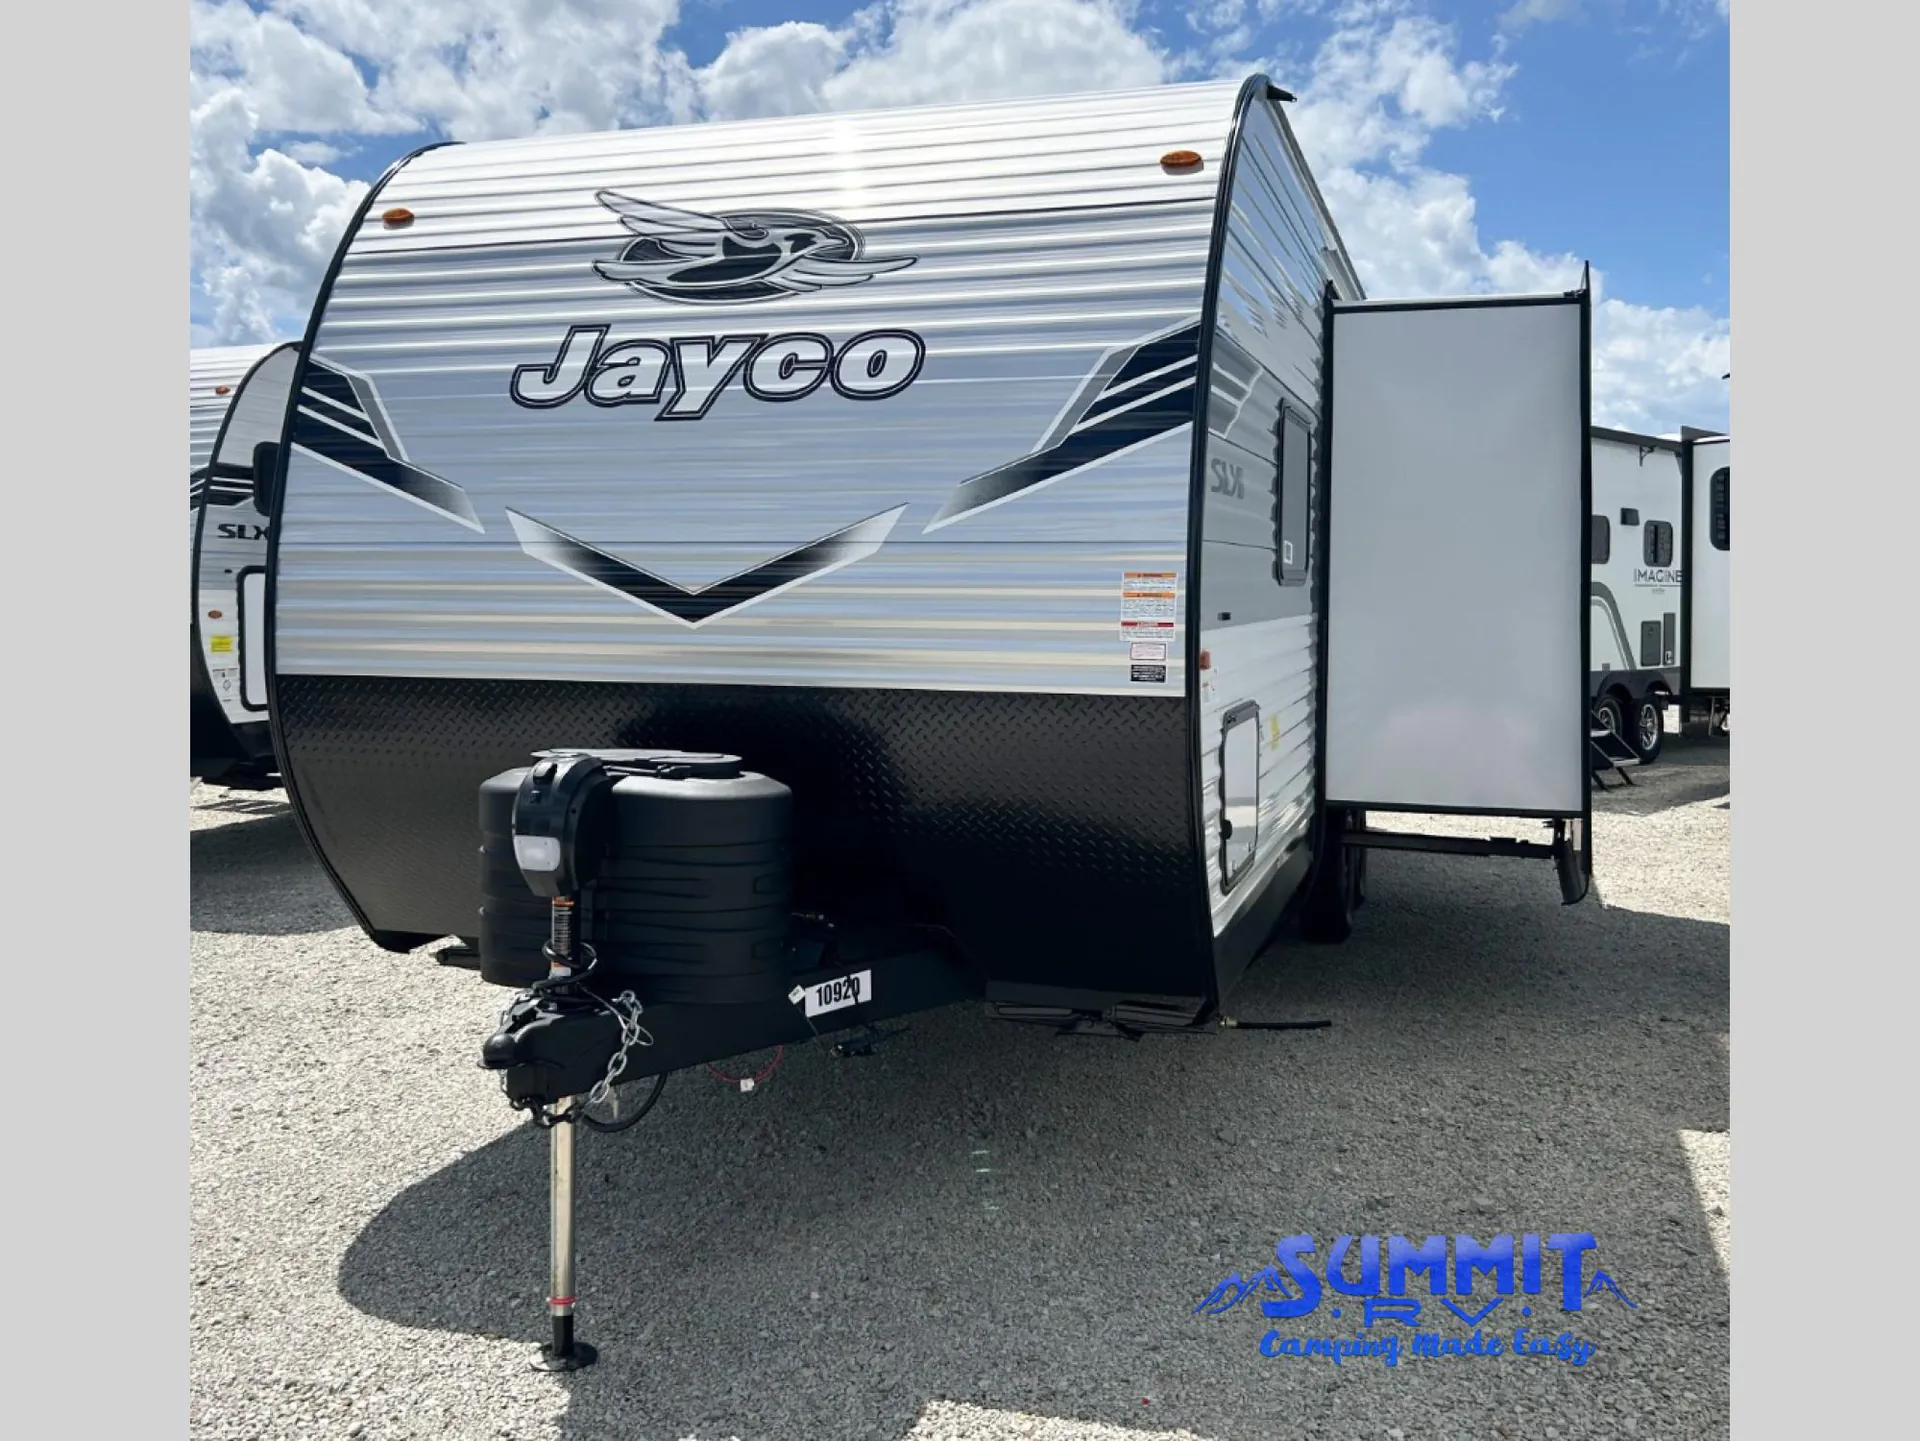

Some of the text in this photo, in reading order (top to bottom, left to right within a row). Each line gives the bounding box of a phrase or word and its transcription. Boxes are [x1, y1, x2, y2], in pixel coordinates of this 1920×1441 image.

[510, 323, 926, 421] Jayco
[1210, 458, 1245, 500] SLX
[217, 523, 270, 540] SLX
[1633, 569, 1683, 583] IMAGINE
[816, 976, 861, 1007] 10920
